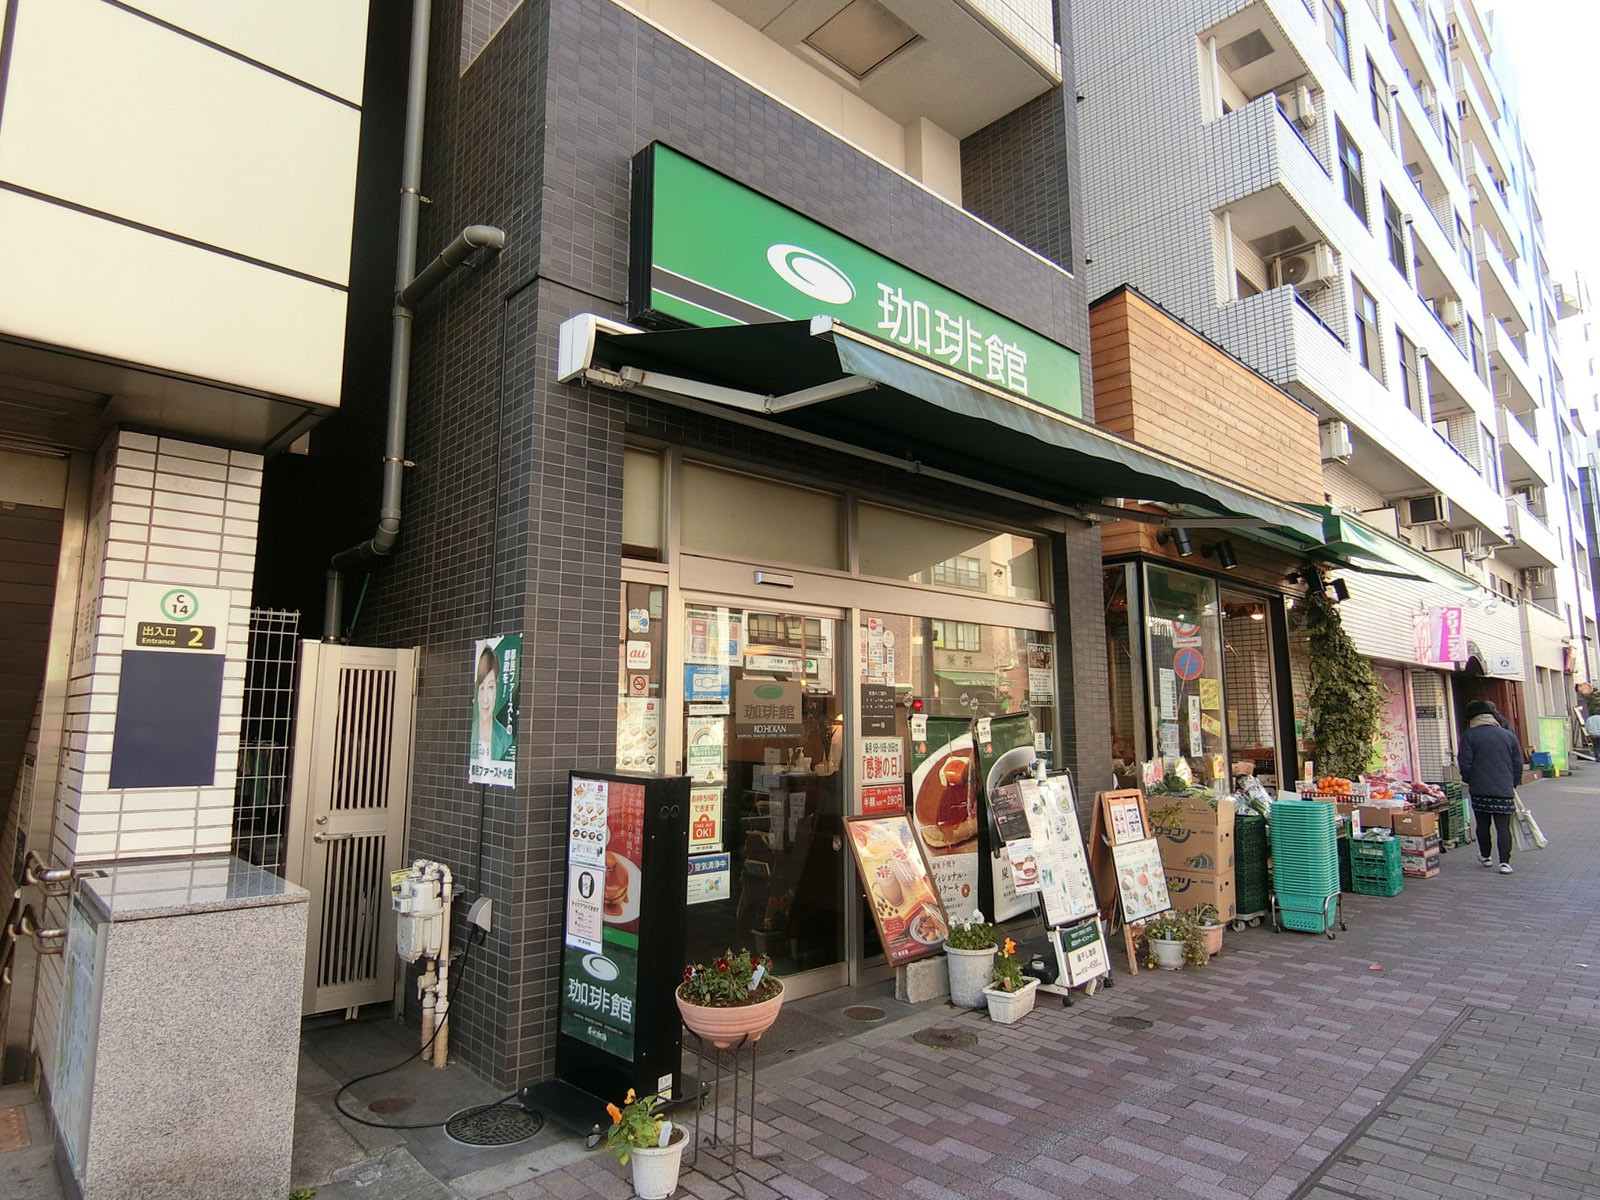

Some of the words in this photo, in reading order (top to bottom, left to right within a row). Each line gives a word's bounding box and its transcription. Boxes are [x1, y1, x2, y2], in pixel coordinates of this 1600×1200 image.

[877, 281, 1028, 397] 珈琲館
[176, 594, 185, 604] C
[172, 604, 189, 615] 14
[142, 626, 177, 637] 出入口
[187, 627, 204, 647] 2
[141, 637, 176, 646] Entrance
[629, 649, 649, 659] au
[506, 649, 516, 735] 都民ファーストの
[744, 704, 795, 720] 珈琲館
[471, 763, 514, 780] 都民ファーストの会
[691, 793, 719, 803] お持ち帰り
[694, 803, 716, 812] できます
[695, 828, 713, 838] OK!
[567, 977, 633, 1025] 珈琲館
